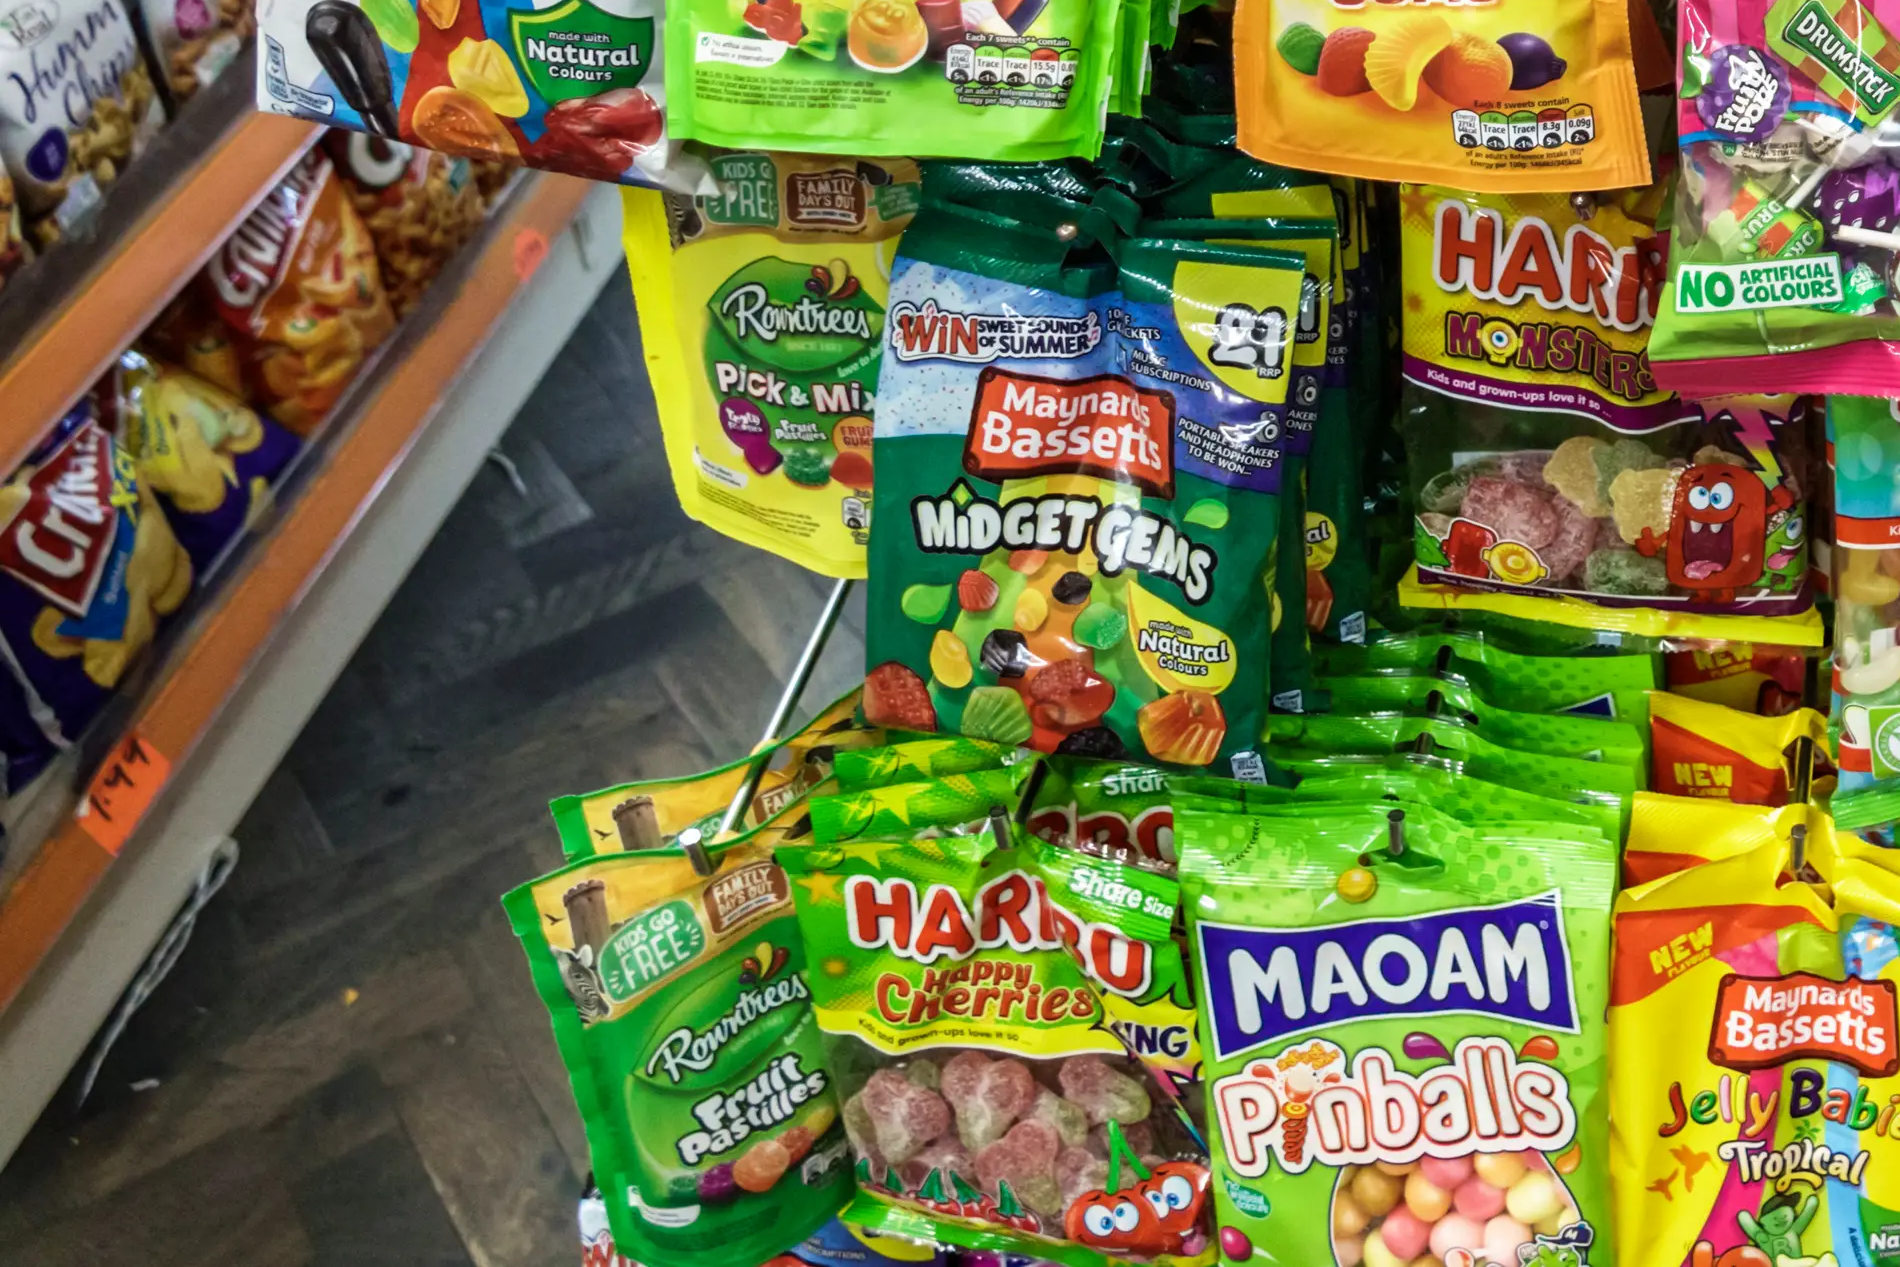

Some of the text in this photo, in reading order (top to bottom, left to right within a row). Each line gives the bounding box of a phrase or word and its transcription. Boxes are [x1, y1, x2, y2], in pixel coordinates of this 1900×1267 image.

[527, 39, 641, 68] Natural
[549, 66, 613, 82] Colours
[1795, 11, 1898, 107] DRUMSTICK
[1483, 118, 1591, 134] Trace Trace 8.3g 0.09g
[1678, 268, 1735, 309] NO
[1738, 263, 1835, 287] ARTIFICIAL
[1742, 279, 1838, 304] COLOURS
[721, 283, 871, 341] Rowntrees
[900, 313, 977, 357] WiN
[979, 334, 1089, 354] OF SUMMER
[714, 361, 786, 406] Pick
[789, 386, 810, 406] &
[1131, 362, 1212, 391] SUBSCRIPTIONS
[1258, 367, 1283, 378] RRP
[1001, 386, 1151, 425] Maynards
[982, 410, 1162, 471] Bassetts
[1178, 430, 1272, 469] AND HEADPHONES
[1097, 508, 1215, 603] GEMS
[1139, 631, 1229, 662] Natural
[1158, 656, 1209, 676] Colours
[1069, 867, 1174, 919] Share Size
[613, 909, 676, 958] KIDS GO
[1649, 920, 1715, 975] NEW
[619, 935, 692, 992] FREE
[924, 959, 1033, 991] Happy
[1227, 921, 1551, 1035] MAOAM
[876, 972, 1095, 1024] Cherries
[1743, 983, 1876, 1017] Maynards
[646, 972, 809, 1083] Rowntrees
[1726, 1009, 1887, 1057] Bassetts
[692, 1051, 804, 1127] Fruit
[1658, 1073, 1780, 1138] Jelly
[676, 1069, 827, 1166] Pastilles
[1718, 1137, 1870, 1194] Tropical
